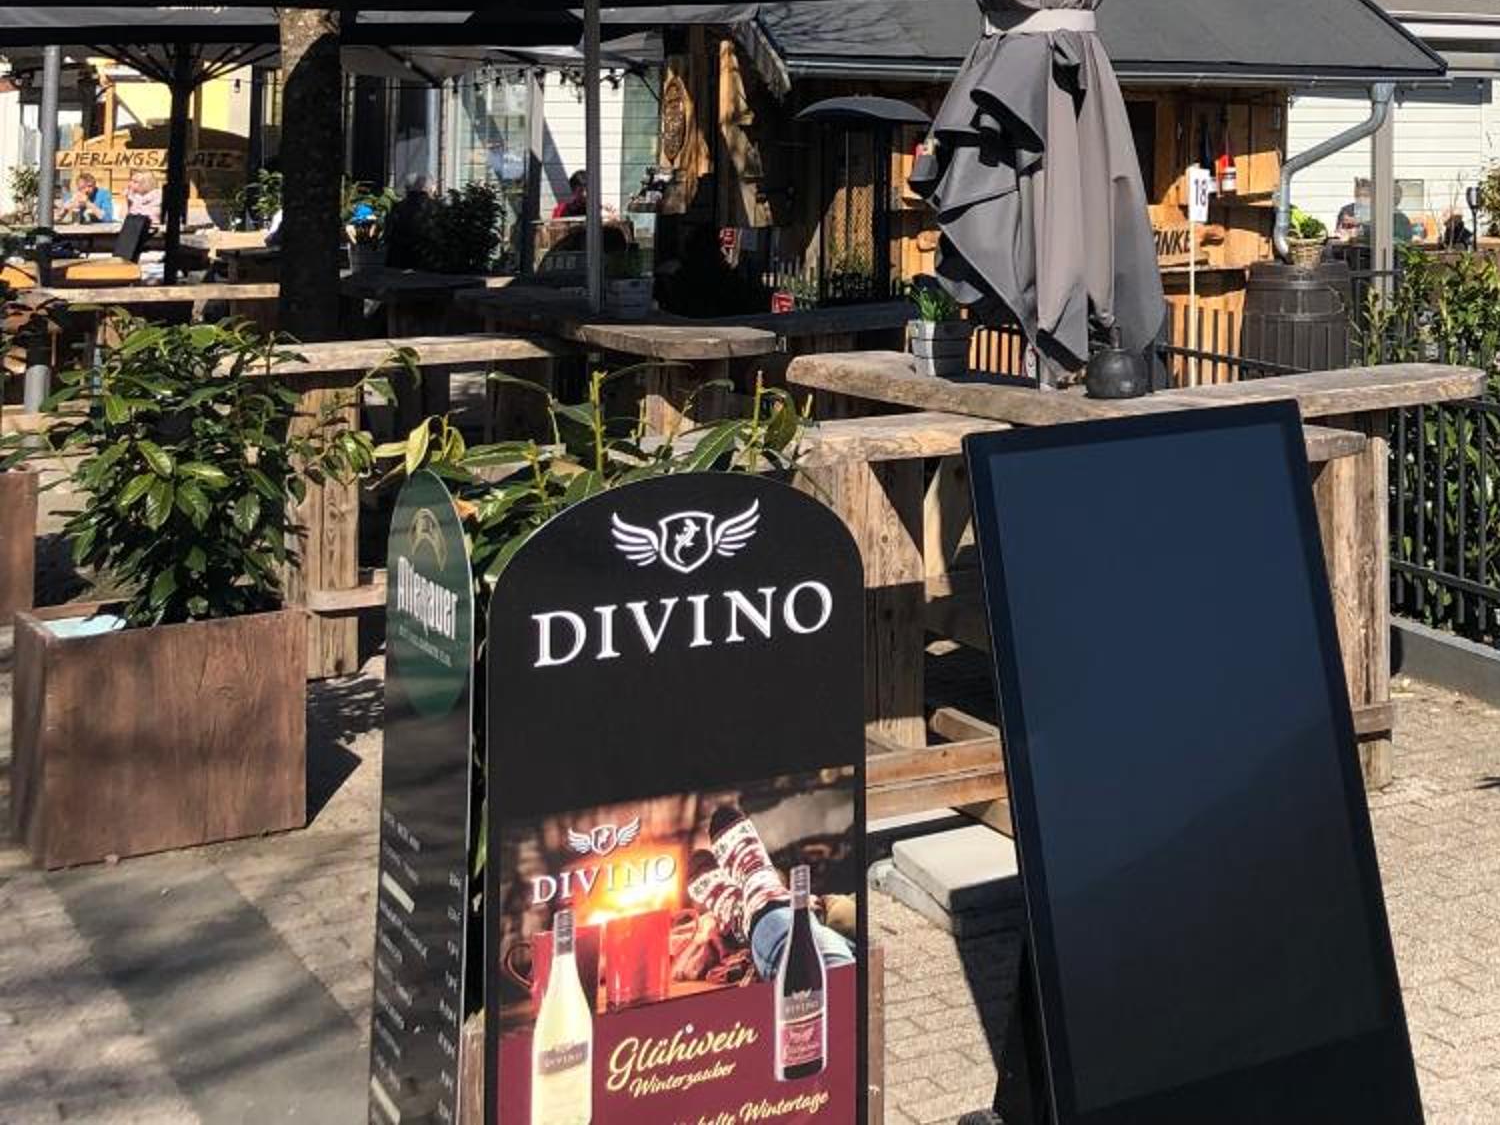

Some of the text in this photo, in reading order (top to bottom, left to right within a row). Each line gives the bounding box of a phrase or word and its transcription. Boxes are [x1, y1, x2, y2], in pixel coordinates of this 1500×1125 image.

[1193, 178, 1209, 207] 18
[531, 580, 833, 667] DIVINO
[531, 854, 677, 905] DIVINO
[607, 1022, 759, 1091] Glühwein
[629, 1059, 737, 1098] Winterzauber
[739, 1090, 829, 1123] Wintertage
